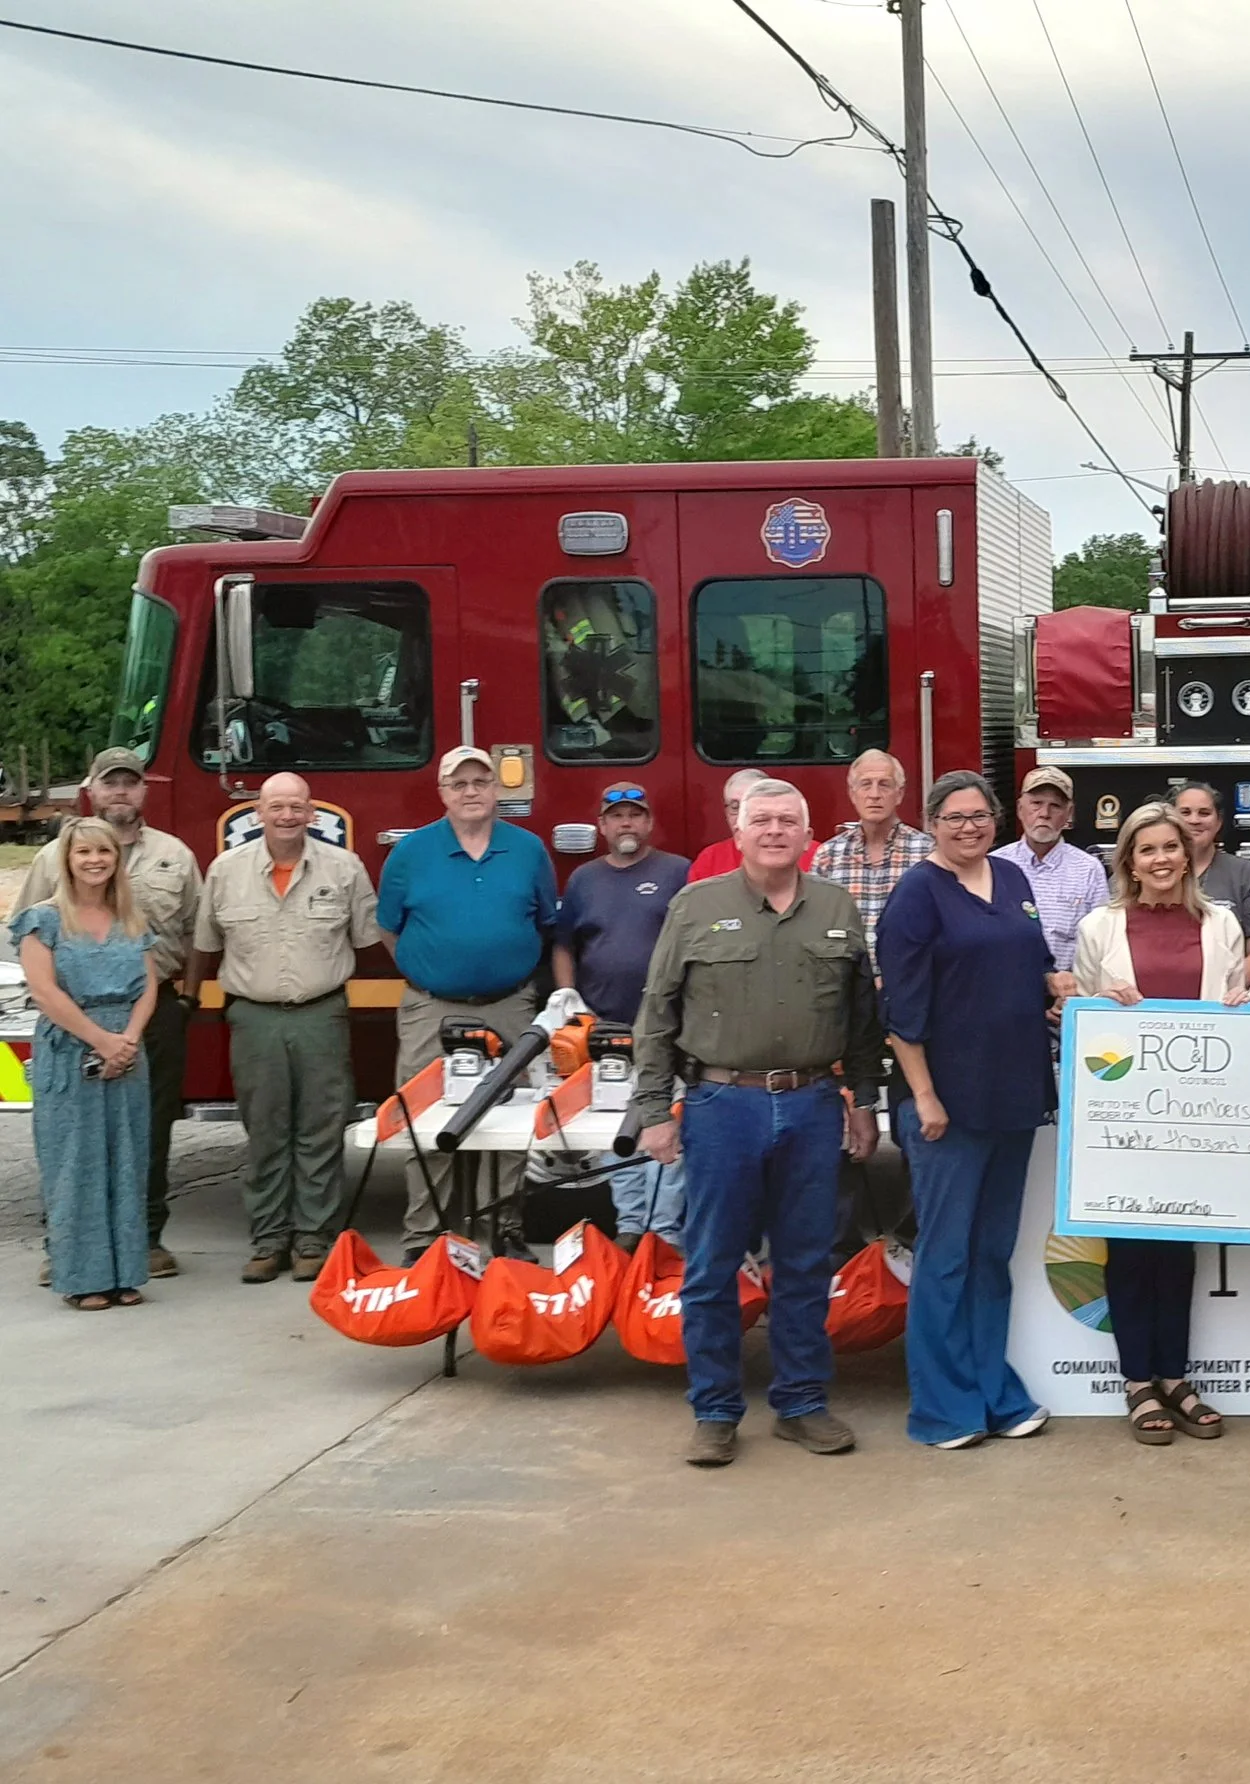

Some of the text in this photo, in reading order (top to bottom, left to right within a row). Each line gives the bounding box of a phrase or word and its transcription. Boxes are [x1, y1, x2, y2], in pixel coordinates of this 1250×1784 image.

[1137, 1034, 1232, 1073] RC&D
[1146, 1088, 1250, 1120] Chambers
[1051, 1360, 1119, 1375] COMMUN
[1184, 1360, 1241, 1374] OPMENT
[1091, 1380, 1129, 1394] NATI
